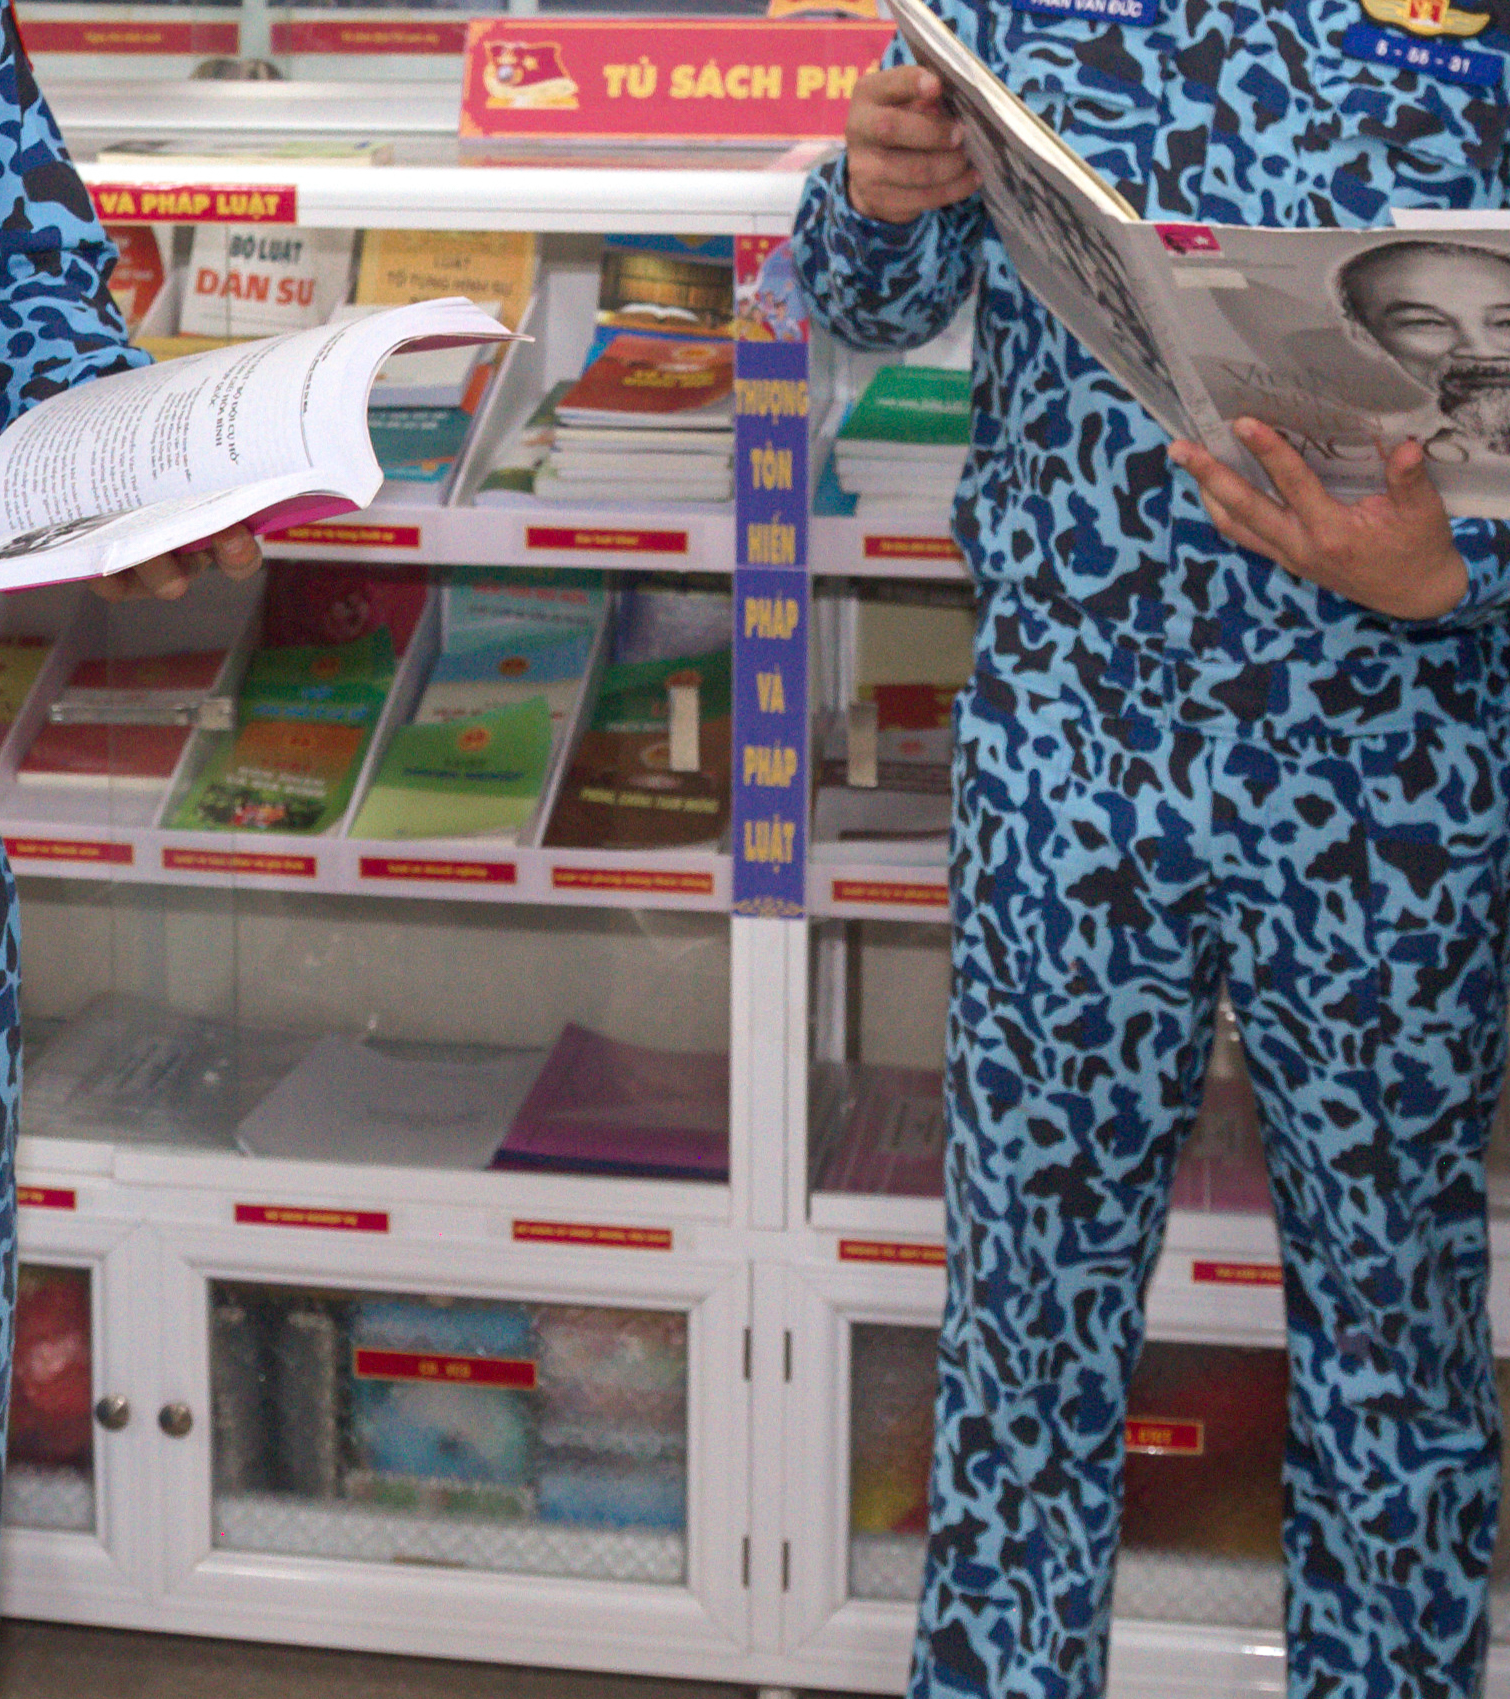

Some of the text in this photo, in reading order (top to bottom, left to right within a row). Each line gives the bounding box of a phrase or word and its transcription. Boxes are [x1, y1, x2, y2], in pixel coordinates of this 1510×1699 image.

[604, 55, 879, 99] TỦ SÁCH PH
[99, 190, 281, 220] VÀ PHÁP LUẬT
